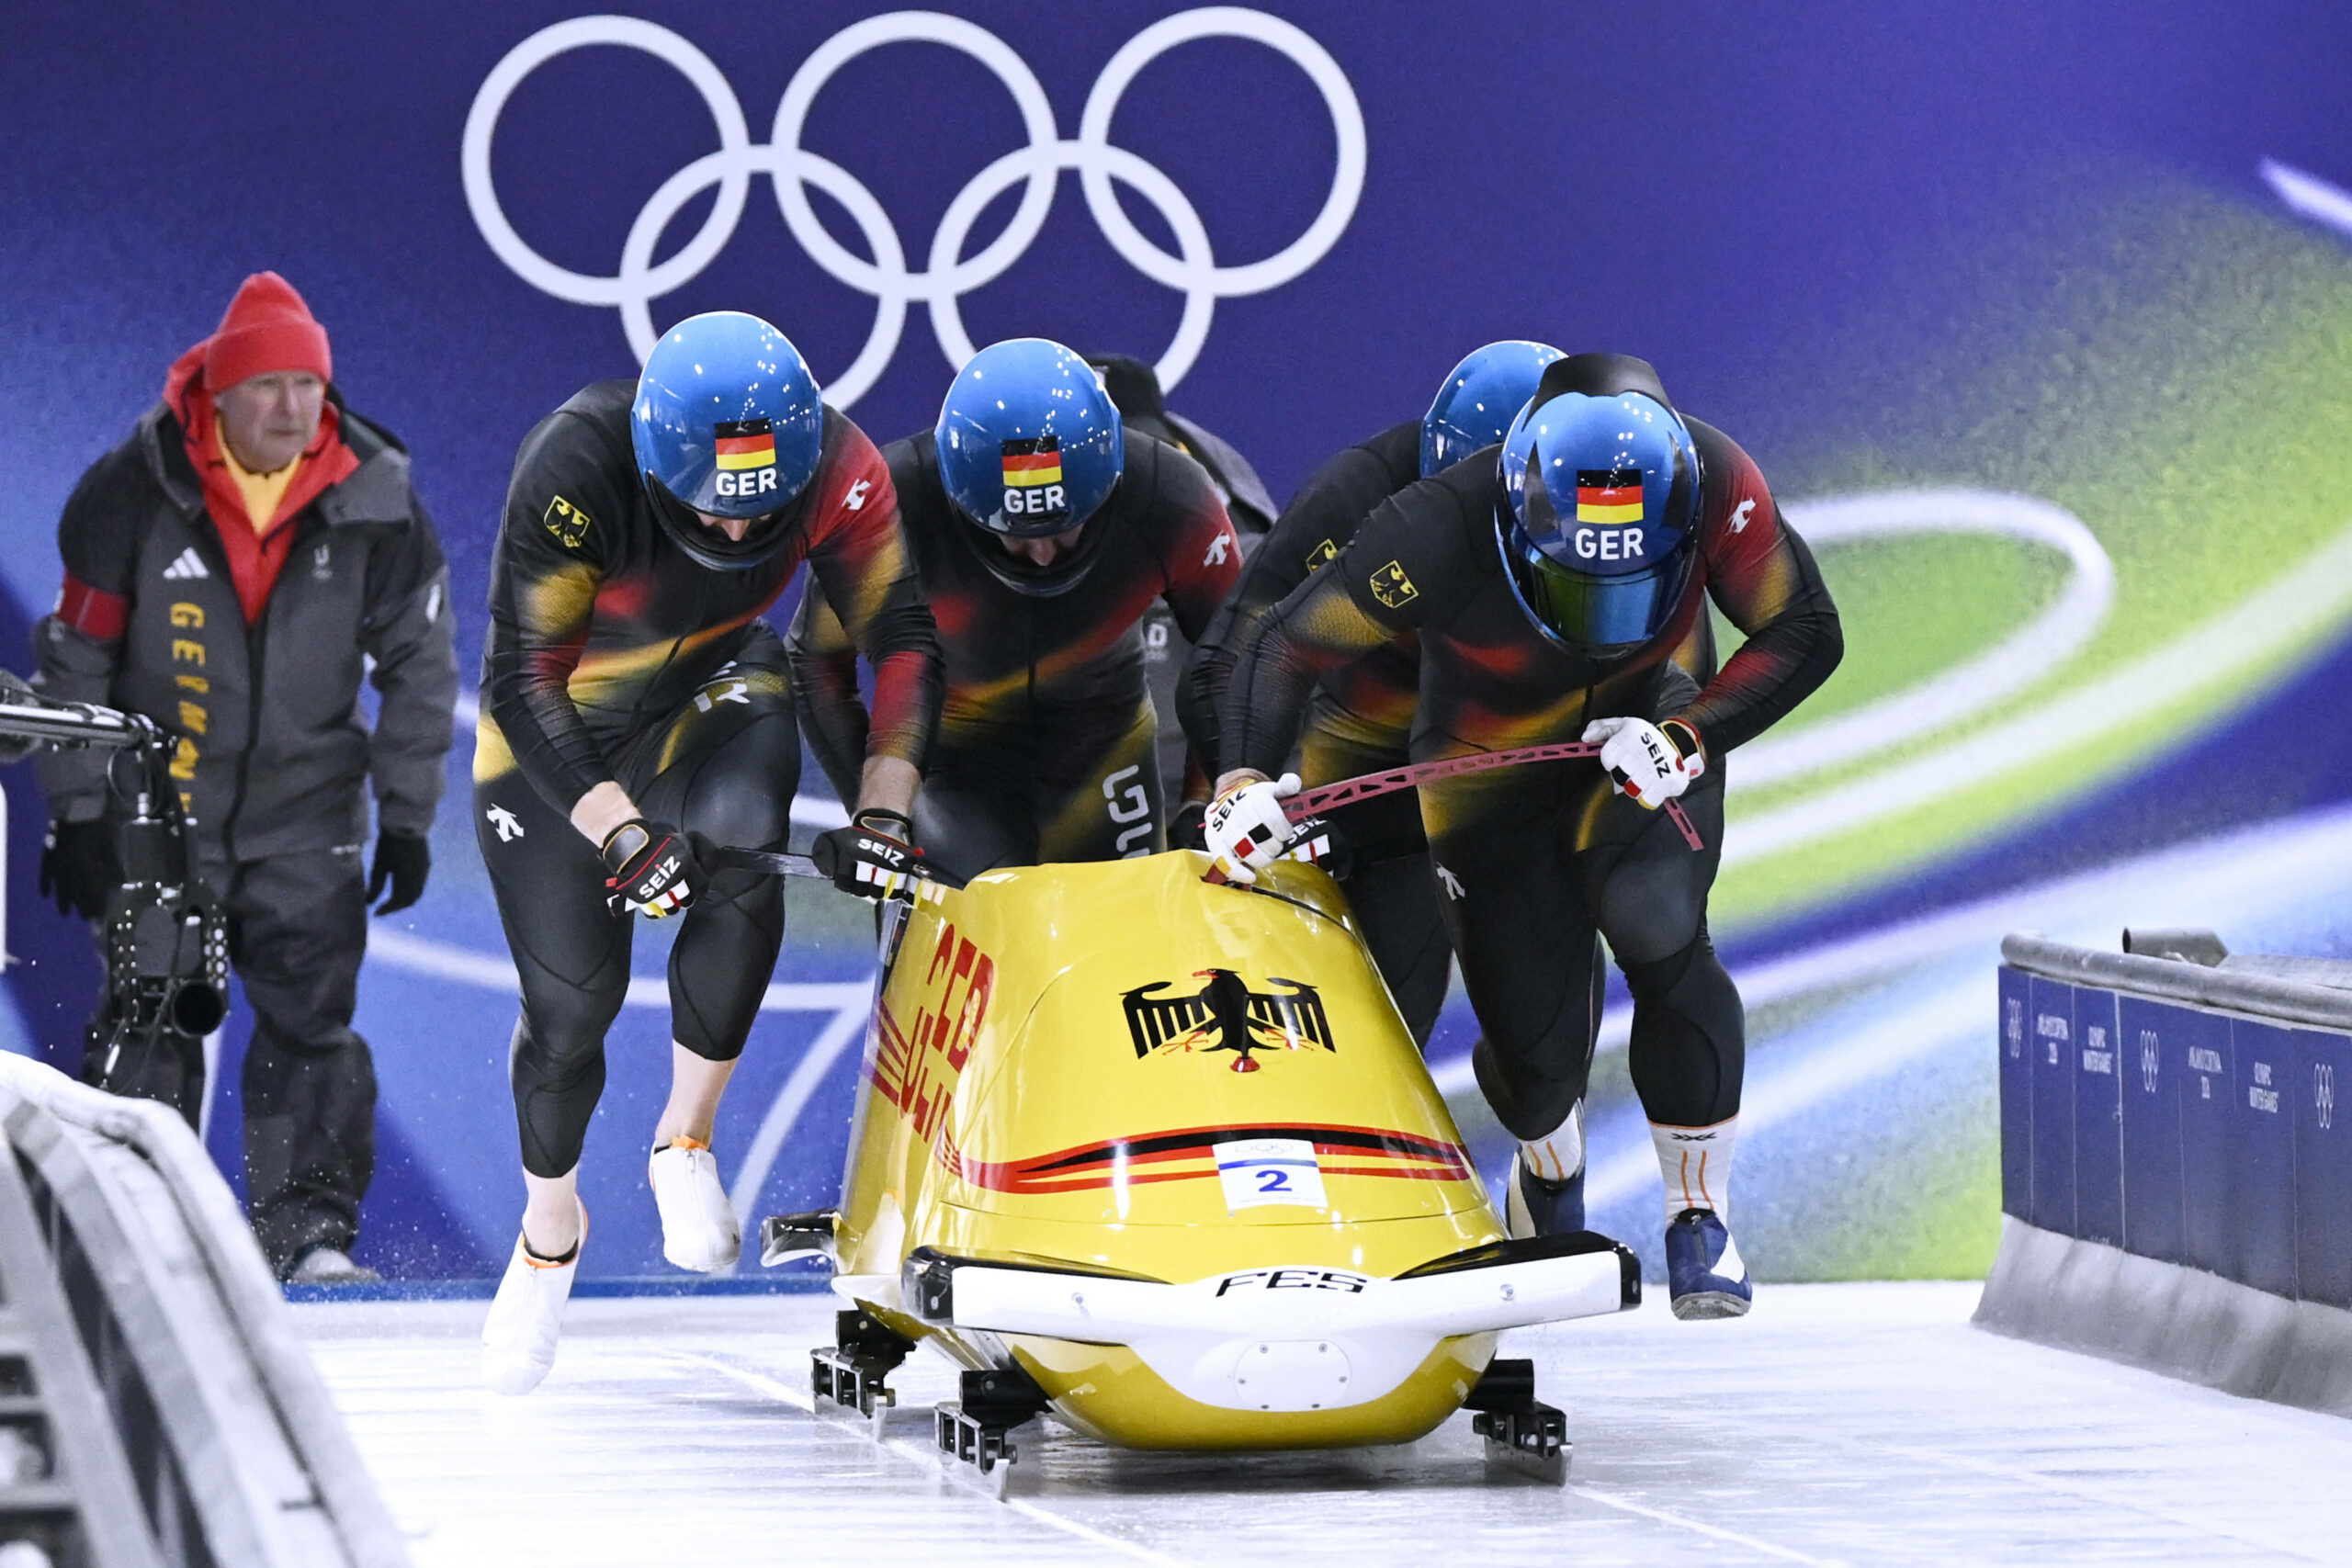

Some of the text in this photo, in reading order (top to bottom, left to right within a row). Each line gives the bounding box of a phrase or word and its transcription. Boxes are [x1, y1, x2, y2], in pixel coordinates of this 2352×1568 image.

[715, 468, 777, 497] GER
[1003, 485, 1065, 514] GER
[1575, 527, 1645, 560] GER
[1255, 1169, 1293, 1192] 2
[1215, 1269, 1368, 1298] FES
